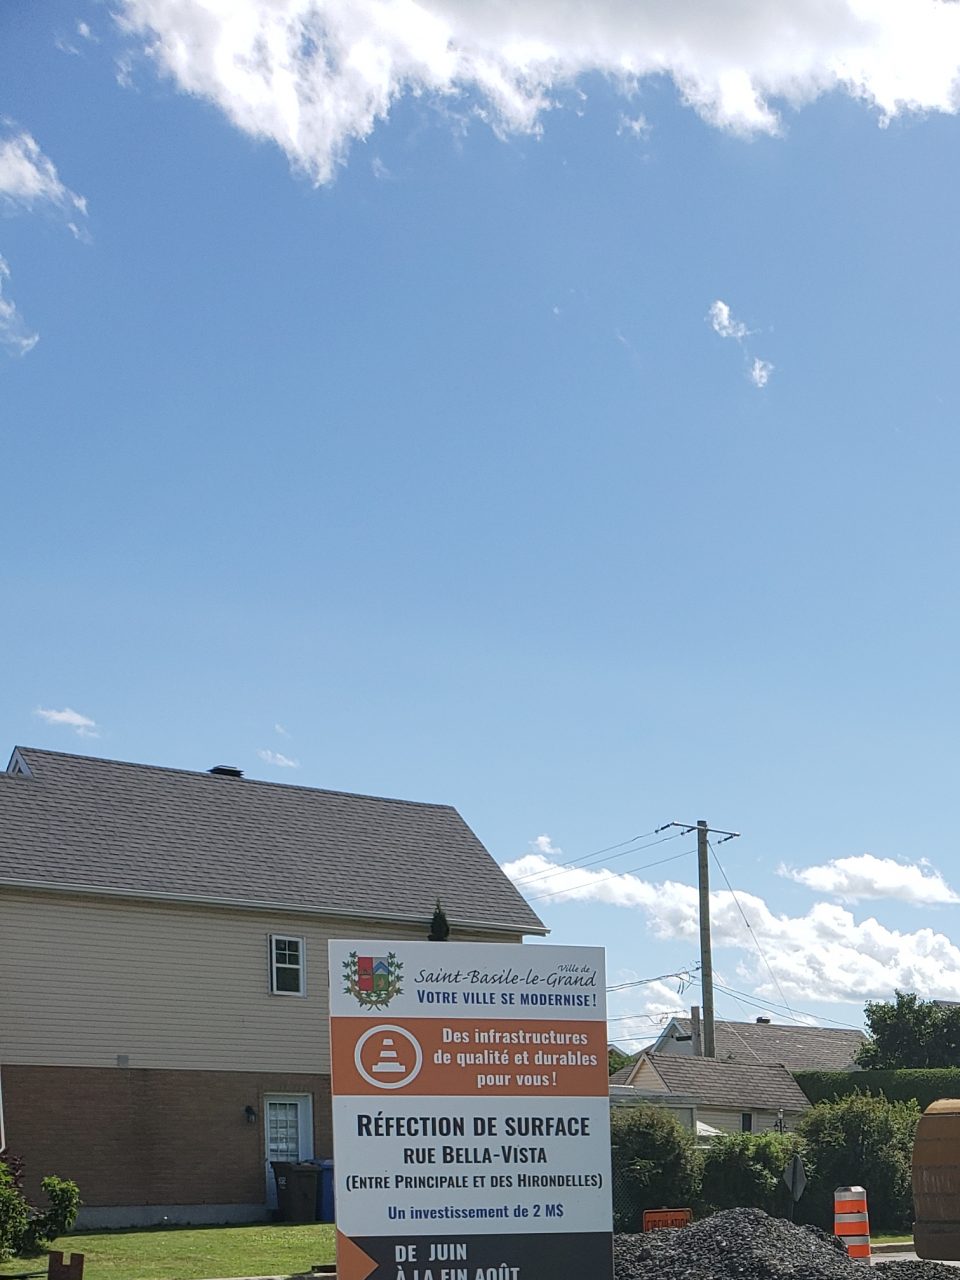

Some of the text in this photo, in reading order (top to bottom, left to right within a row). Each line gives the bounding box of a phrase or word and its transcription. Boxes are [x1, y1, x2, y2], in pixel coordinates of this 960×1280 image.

[557, 963, 590, 973] Ville de
[414, 968, 597, 988] Saint-Basile-le-Grand
[417, 990, 458, 1005] VOTRE
[463, 992, 496, 1005] VILLE
[501, 993, 515, 1005] SE
[443, 1028, 587, 1045] Des infrastructures
[434, 1049, 597, 1068] de qualité et durables
[478, 1074, 511, 1088] pour
[357, 1111, 590, 1136] RÉFECTION DE SURFACE
[404, 1146, 547, 1164] RUE BELLA-VISTA
[346, 1173, 602, 1191] (ENTRE PRINCIPALE ET DES HIRONDELLES)
[388, 1203, 564, 1219] Un investissement de 2 M$
[395, 1244, 467, 1262] DE JUIN
